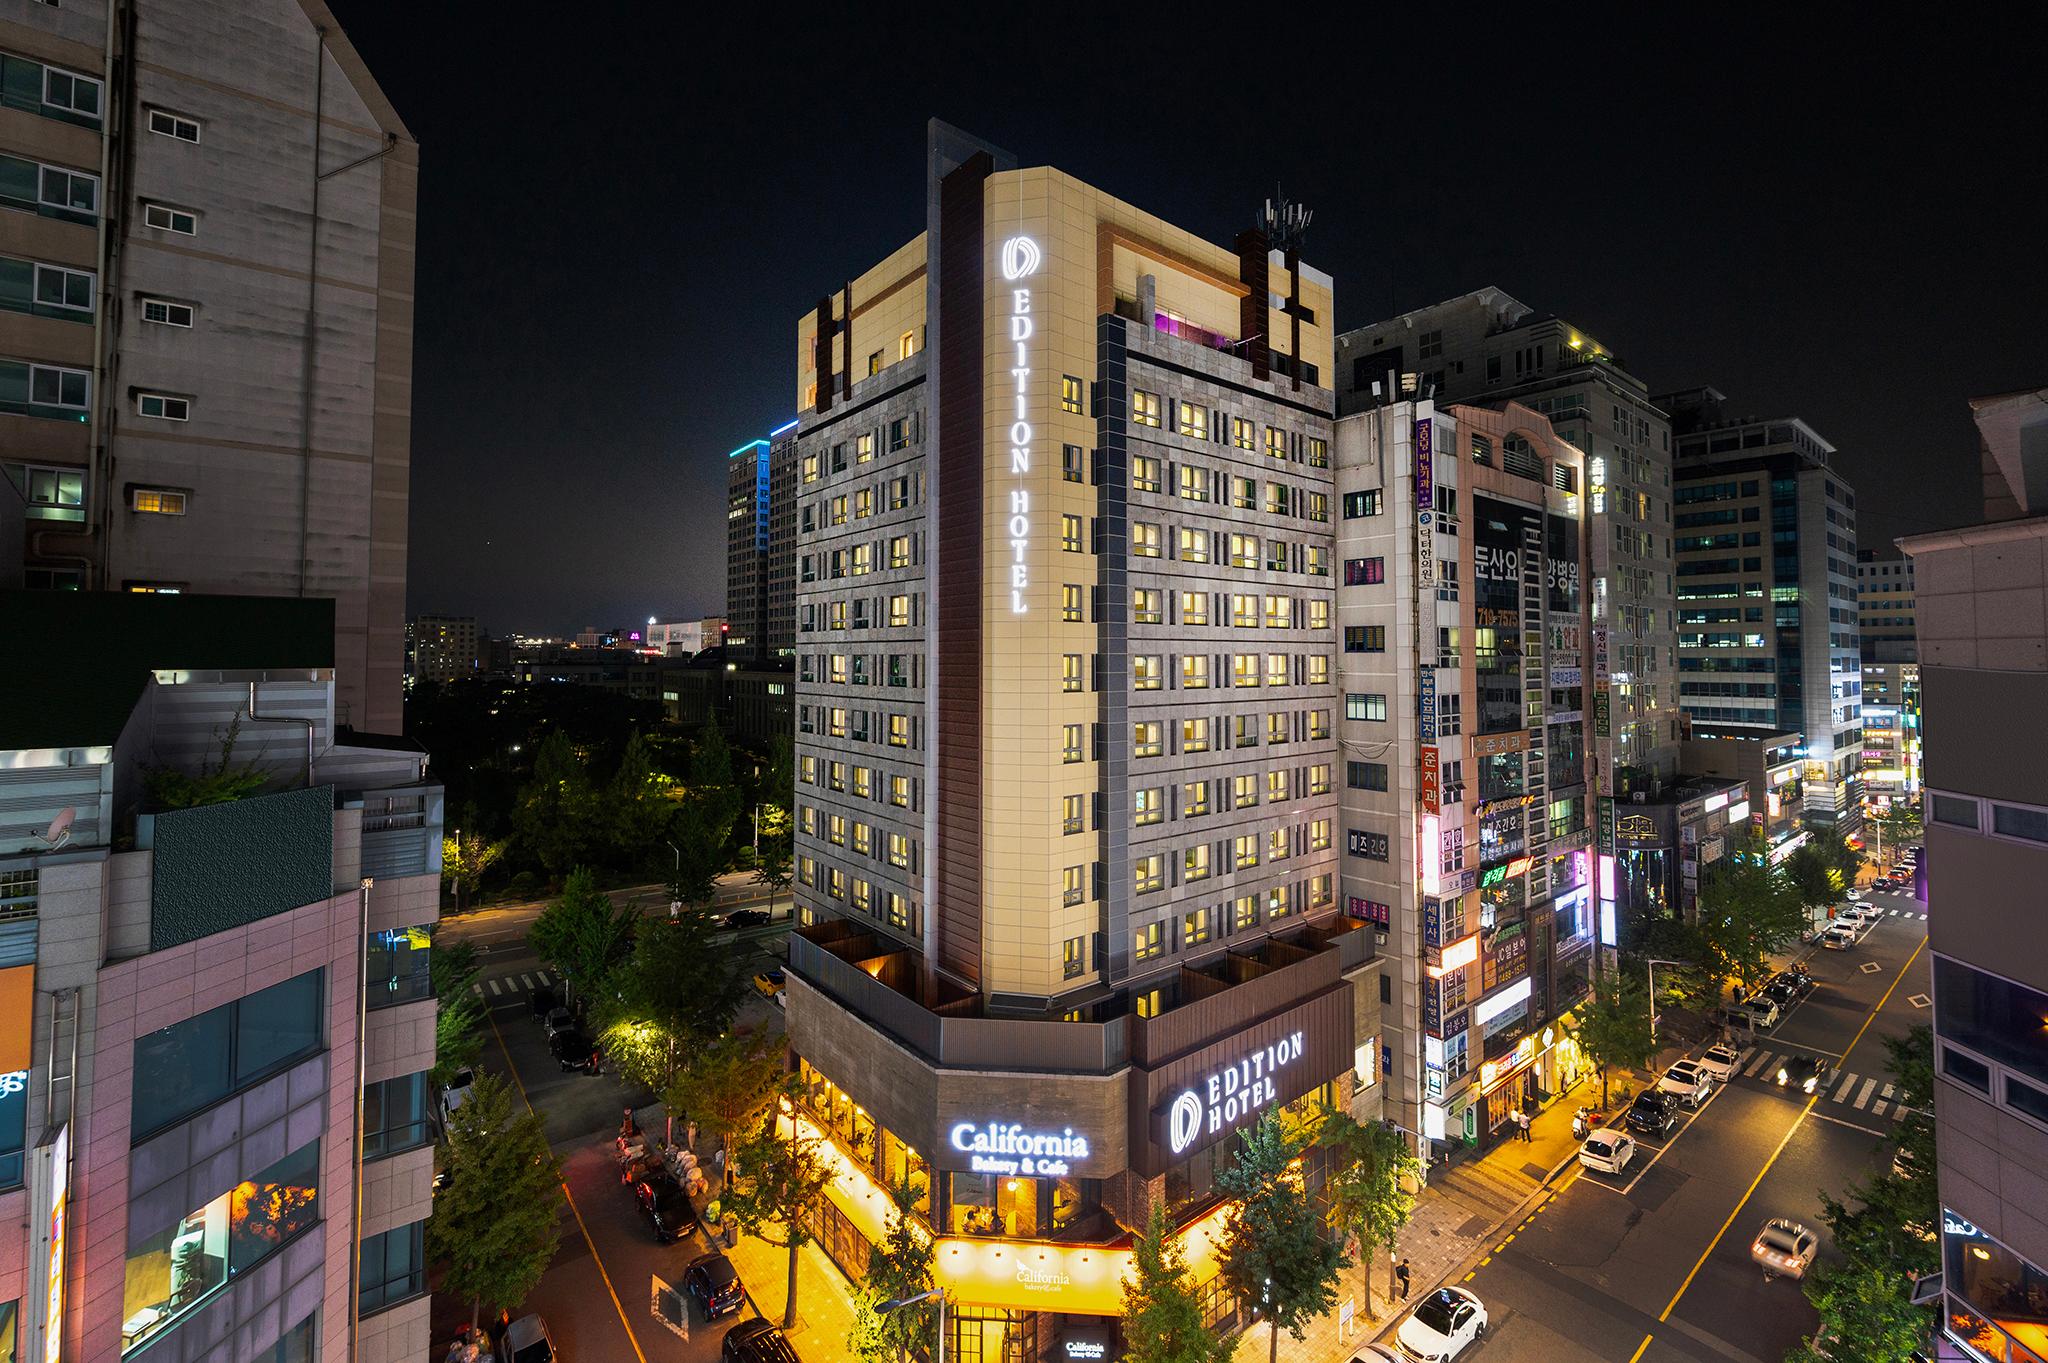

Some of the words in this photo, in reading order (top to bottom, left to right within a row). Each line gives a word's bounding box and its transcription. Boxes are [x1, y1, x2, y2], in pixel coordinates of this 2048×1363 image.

[1011, 289, 1032, 474] EDITION
[1010, 491, 1028, 613] HOTEL
[1420, 528, 1432, 580] 닥터한의원
[1424, 752, 1437, 805] 준치과
[1350, 834, 1386, 856] 미즈간호
[1426, 904, 1438, 939] 세무사
[1207, 1031, 1303, 1106] EDITION
[1208, 1076, 1276, 1134] HOTEL
[951, 1123, 1089, 1157] California
[971, 1155, 1019, 1176] Bakery
[1021, 1157, 1035, 1174] &
[1016, 1269, 1070, 1285] California
[1065, 1341, 1105, 1353] California
